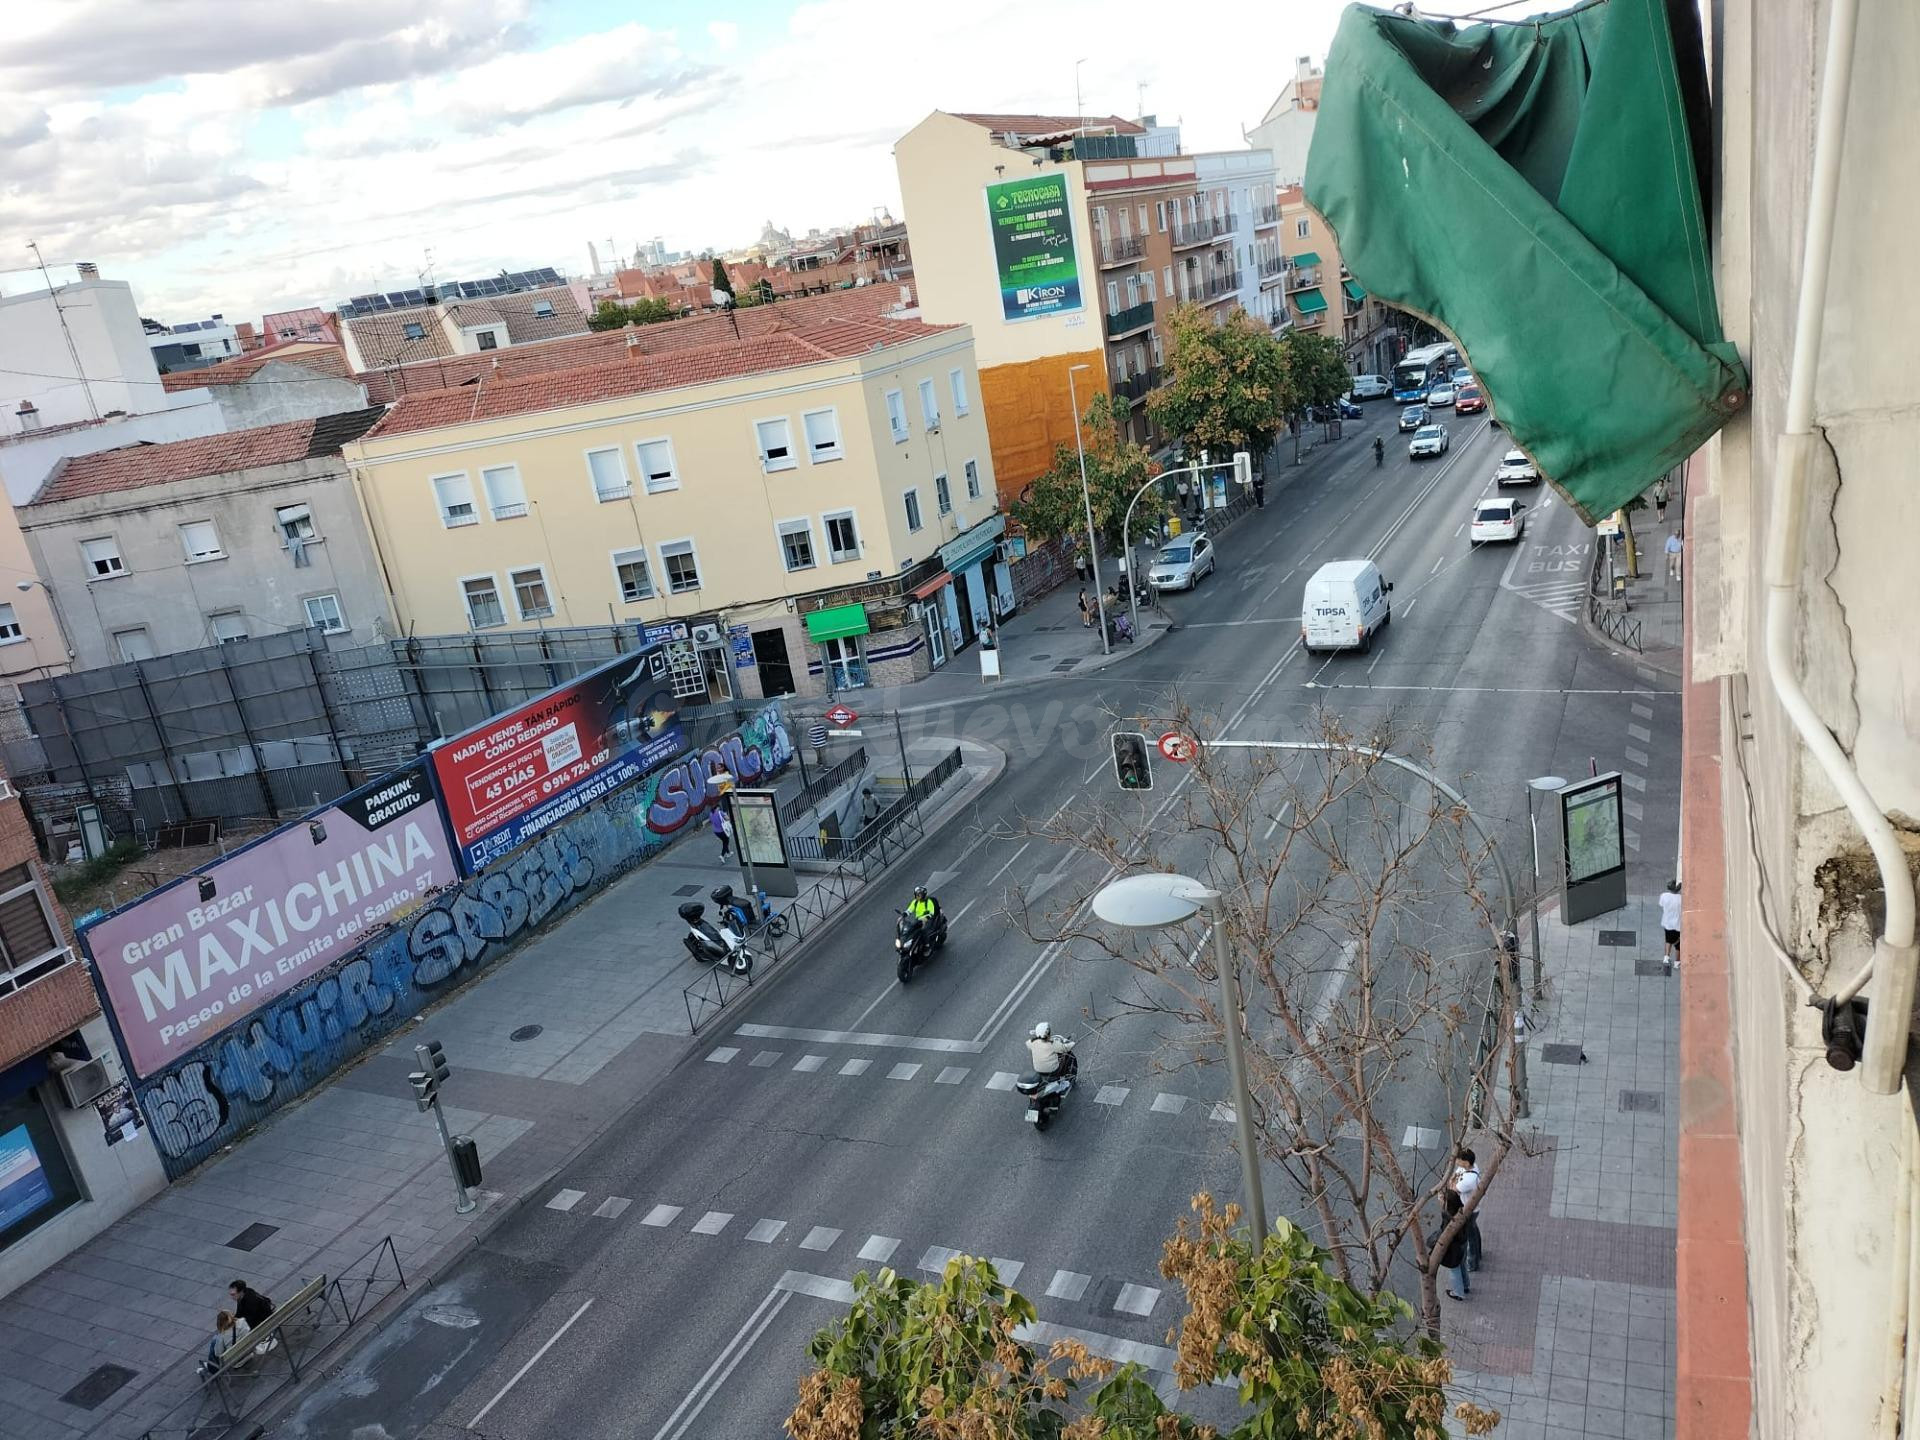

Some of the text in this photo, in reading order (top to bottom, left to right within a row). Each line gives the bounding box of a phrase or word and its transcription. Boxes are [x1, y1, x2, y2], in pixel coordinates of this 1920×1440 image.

[1011, 184, 1061, 206] TECNOCASA
[1528, 560, 1581, 573] BUS
[1534, 543, 1590, 557] TAXI
[1316, 607, 1346, 617] TIPSA
[453, 739, 487, 763] NADIE
[489, 722, 524, 746] VENDE
[546, 693, 582, 719] RÁPIDO
[833, 712, 849, 721] Metro
[484, 737, 517, 760] COMO
[518, 716, 560, 744] REDPISO
[469, 766, 508, 790] VENDEMOS
[507, 760, 519, 773] SU
[516, 753, 534, 769] PISO
[486, 765, 536, 800] 45 DÍAS
[552, 771, 571, 789] 914
[571, 761, 591, 778] 724
[591, 748, 611, 766] 087
[520, 761, 640, 839] FINANCIACIÓN HASTA EL 100%
[556, 792, 572, 806] para
[576, 778, 595, 794] compra
[594, 772, 601, 783] de
[368, 792, 421, 826] GRATUITO
[122, 884, 255, 965] Gran Bazar
[131, 821, 436, 1023] MAXICHINA
[159, 999, 224, 1045] Paseo
[227, 982, 253, 1005] de
[254, 969, 275, 988] la
[275, 933, 335, 975] Ermita
[336, 913, 363, 940] del
[364, 888, 415, 923] Santo,
[415, 869, 433, 892] 57
[98, 1084, 126, 1108] SALSA
